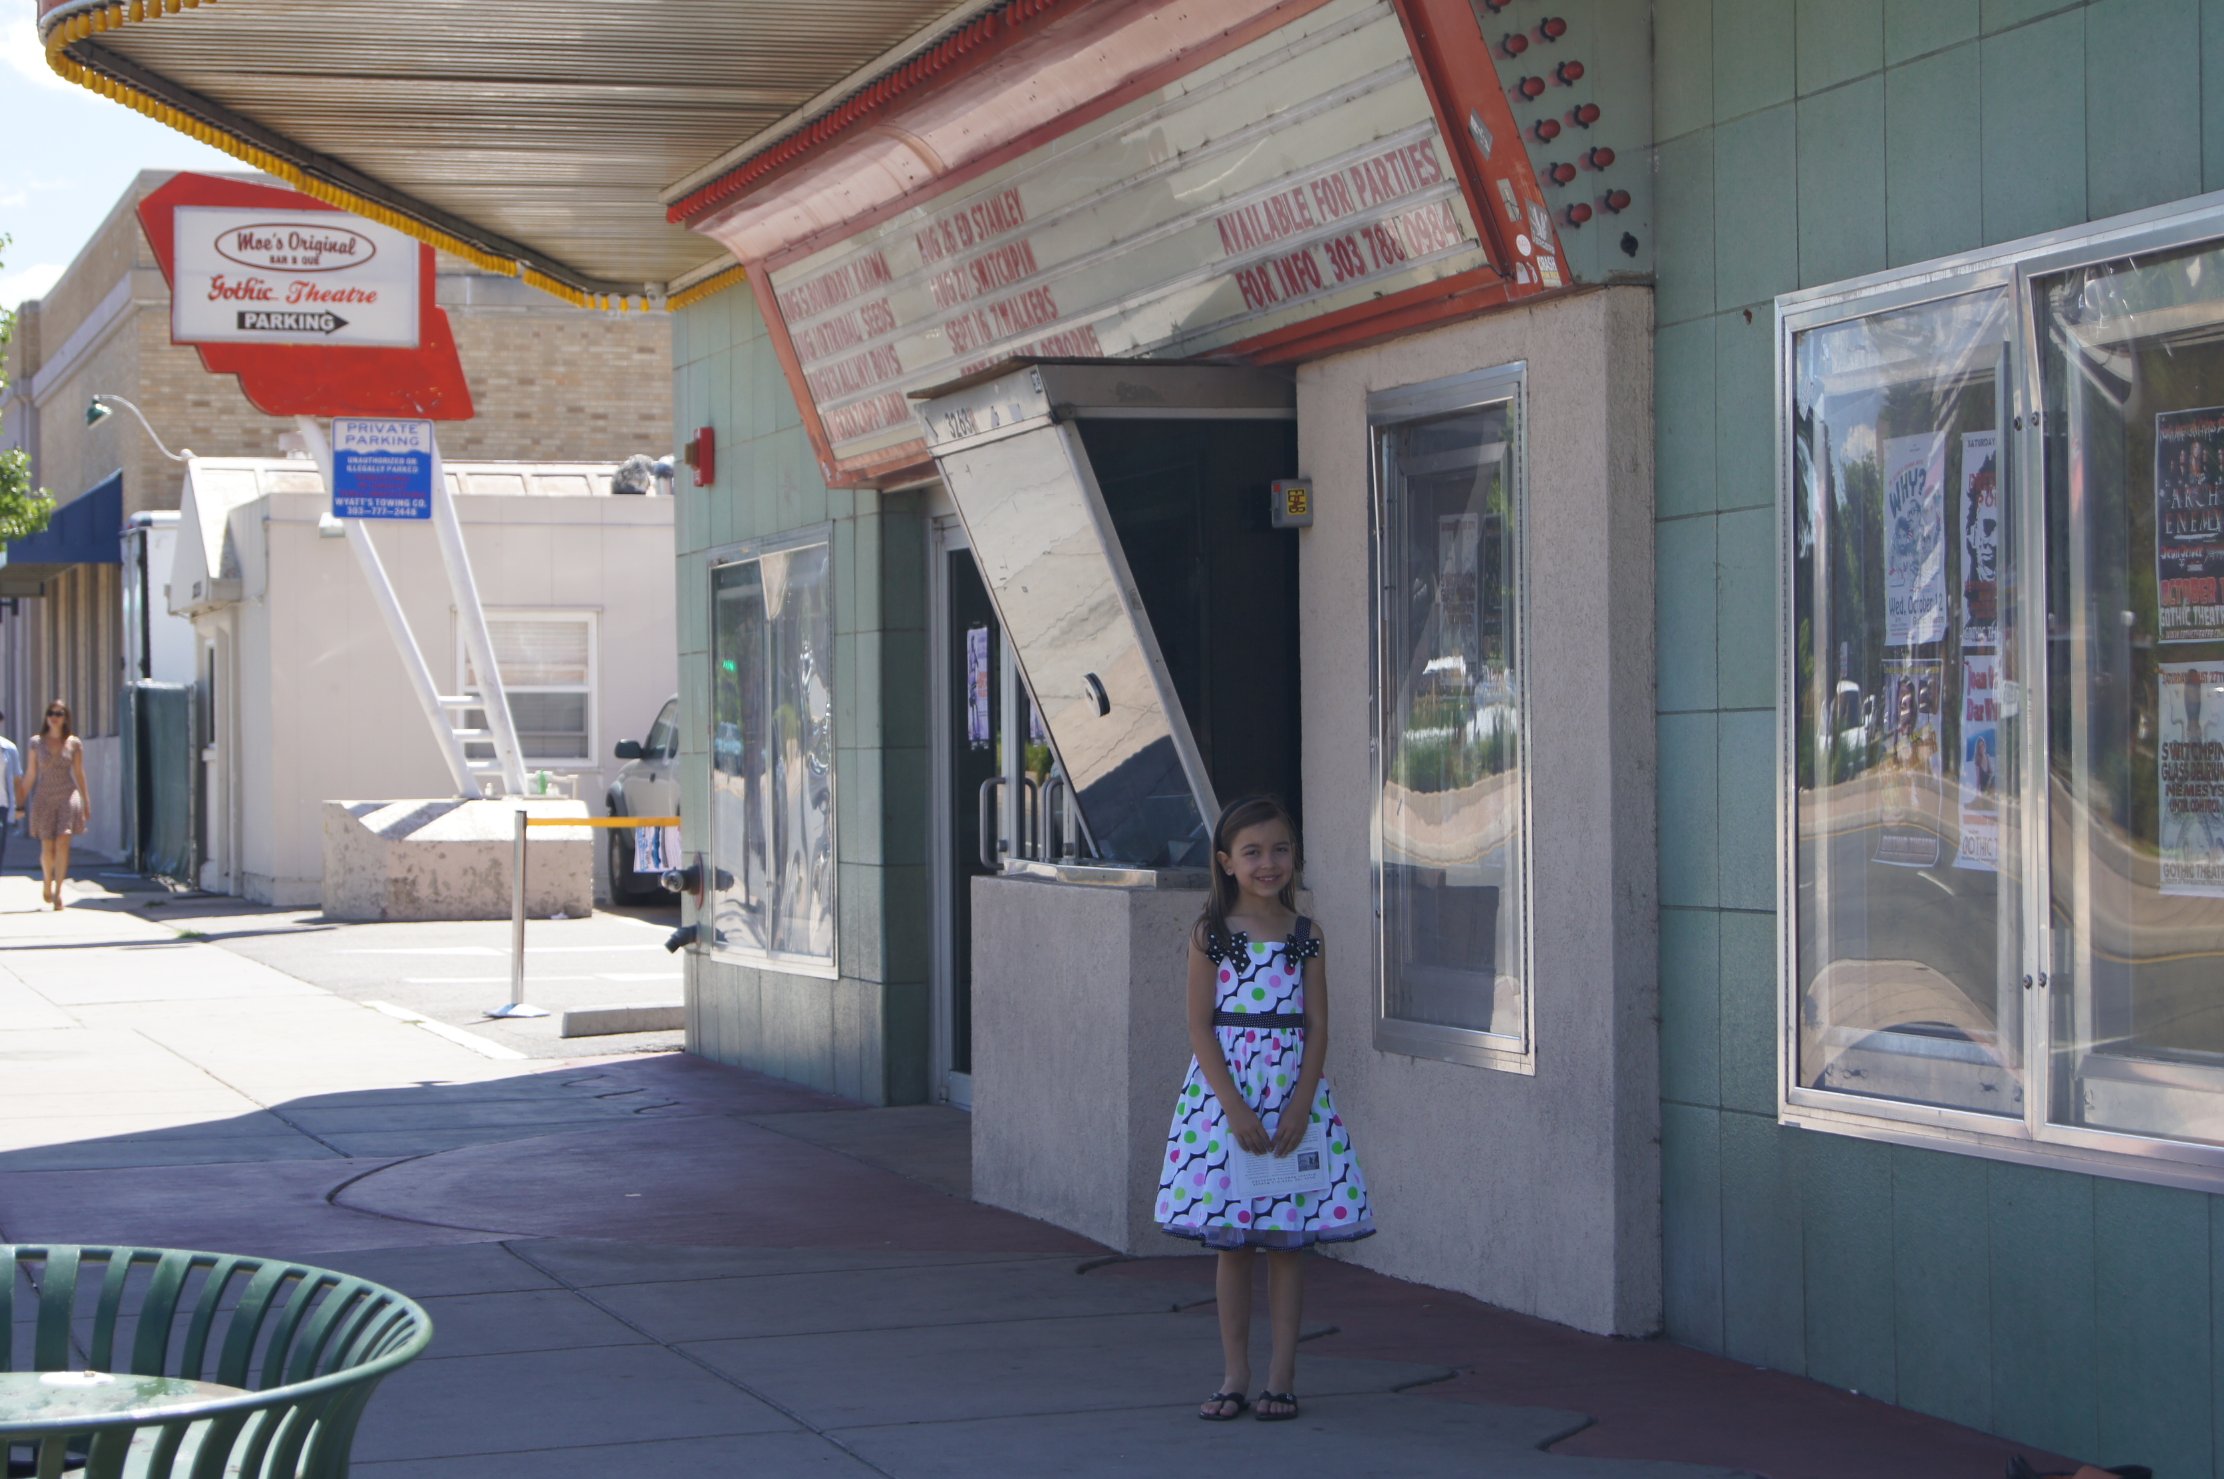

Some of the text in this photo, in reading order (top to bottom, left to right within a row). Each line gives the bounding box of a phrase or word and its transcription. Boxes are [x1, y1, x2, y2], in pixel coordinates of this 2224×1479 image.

[1216, 138, 1441, 256] AVAILABLE FOR PARTIES
[954, 211, 974, 248] ED
[970, 187, 1025, 240] STANLEY
[237, 231, 356, 256] Moe's Original
[269, 254, 288, 264] BAR
[1235, 264, 1279, 311] FOR
[1272, 250, 1322, 298] INFO
[1324, 235, 1366, 282] 303
[1402, 201, 1461, 256] 0984
[207, 274, 378, 305] Gothic Theatre
[244, 312, 335, 331] PARKING
[347, 422, 418, 434] PRIVATE
[345, 434, 420, 446] PARKING
[346, 465, 418, 473] ILLEGALLY PARKED
[347, 456, 405, 465] UNAUTHORIZED
[375, 498, 410, 507] TOWING
[1889, 467, 1927, 519] WHY?
